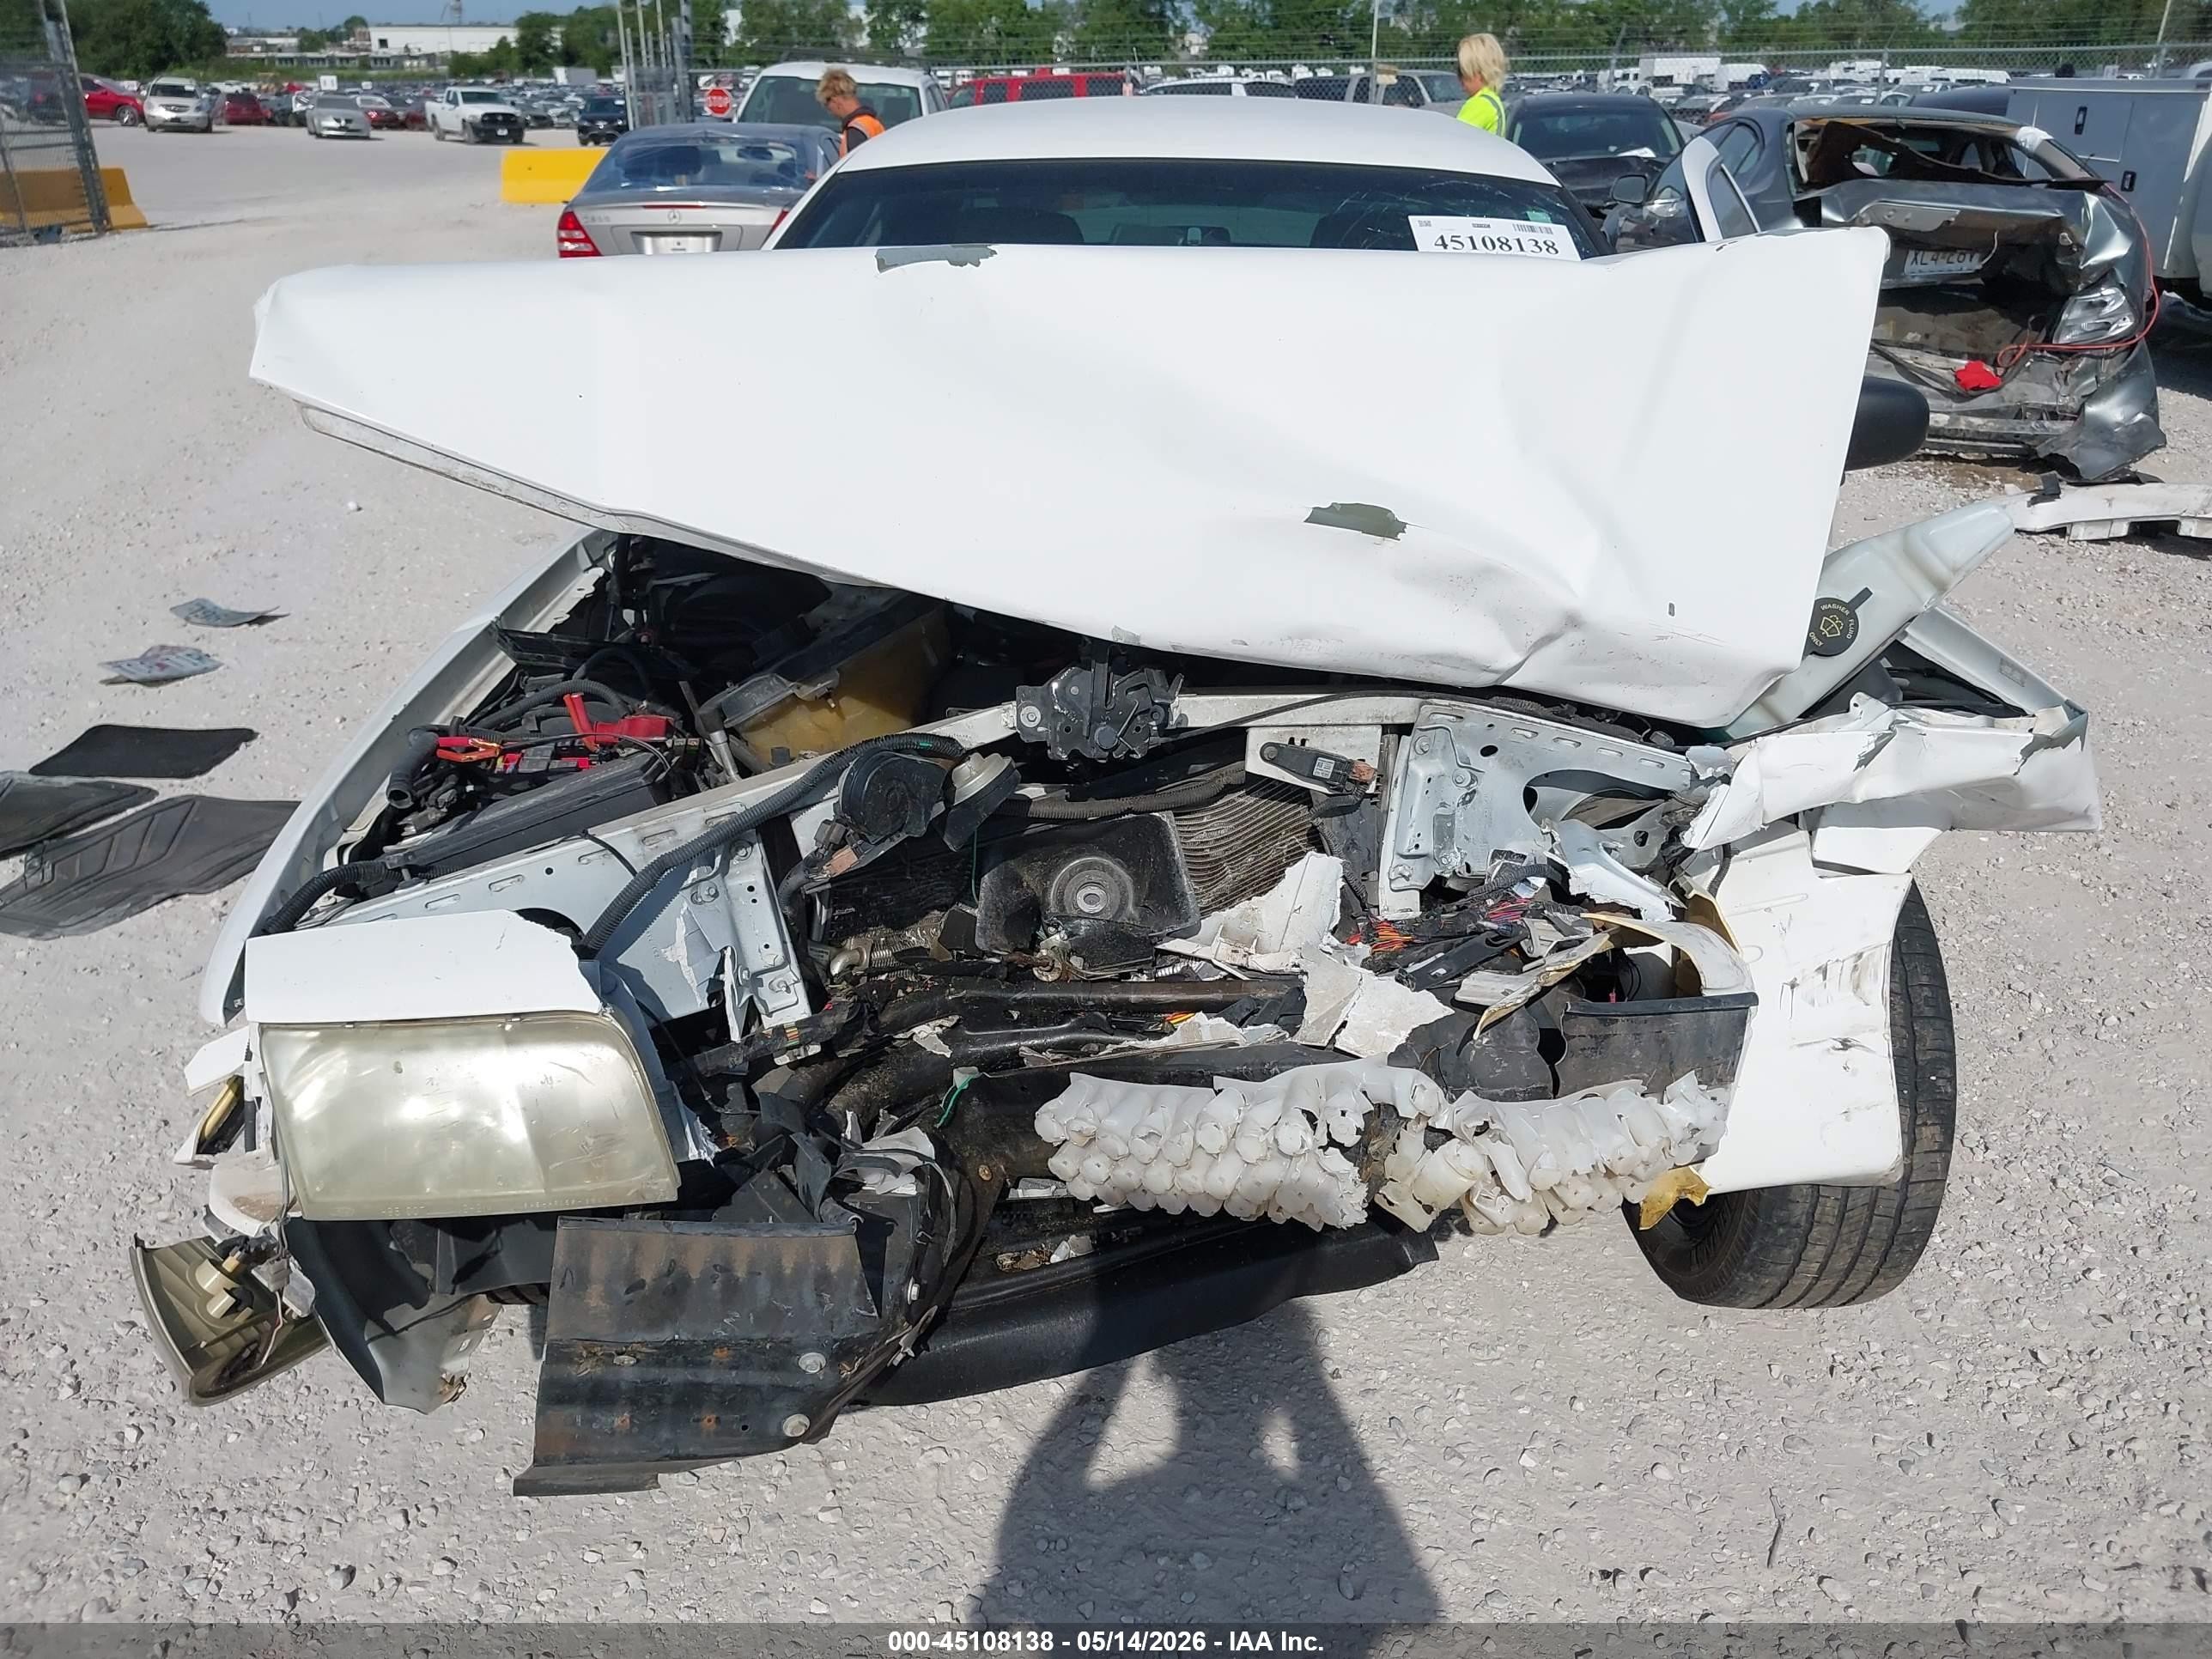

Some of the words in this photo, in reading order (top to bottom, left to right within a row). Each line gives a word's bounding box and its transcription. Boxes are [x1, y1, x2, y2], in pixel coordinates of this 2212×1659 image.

[708, 95, 730, 106] STOP
[1434, 234, 1559, 255] 45108138
[1820, 603, 1850, 616] WASHER
[1846, 618, 1855, 639] FLUID
[1808, 631, 1824, 647] ONLY
